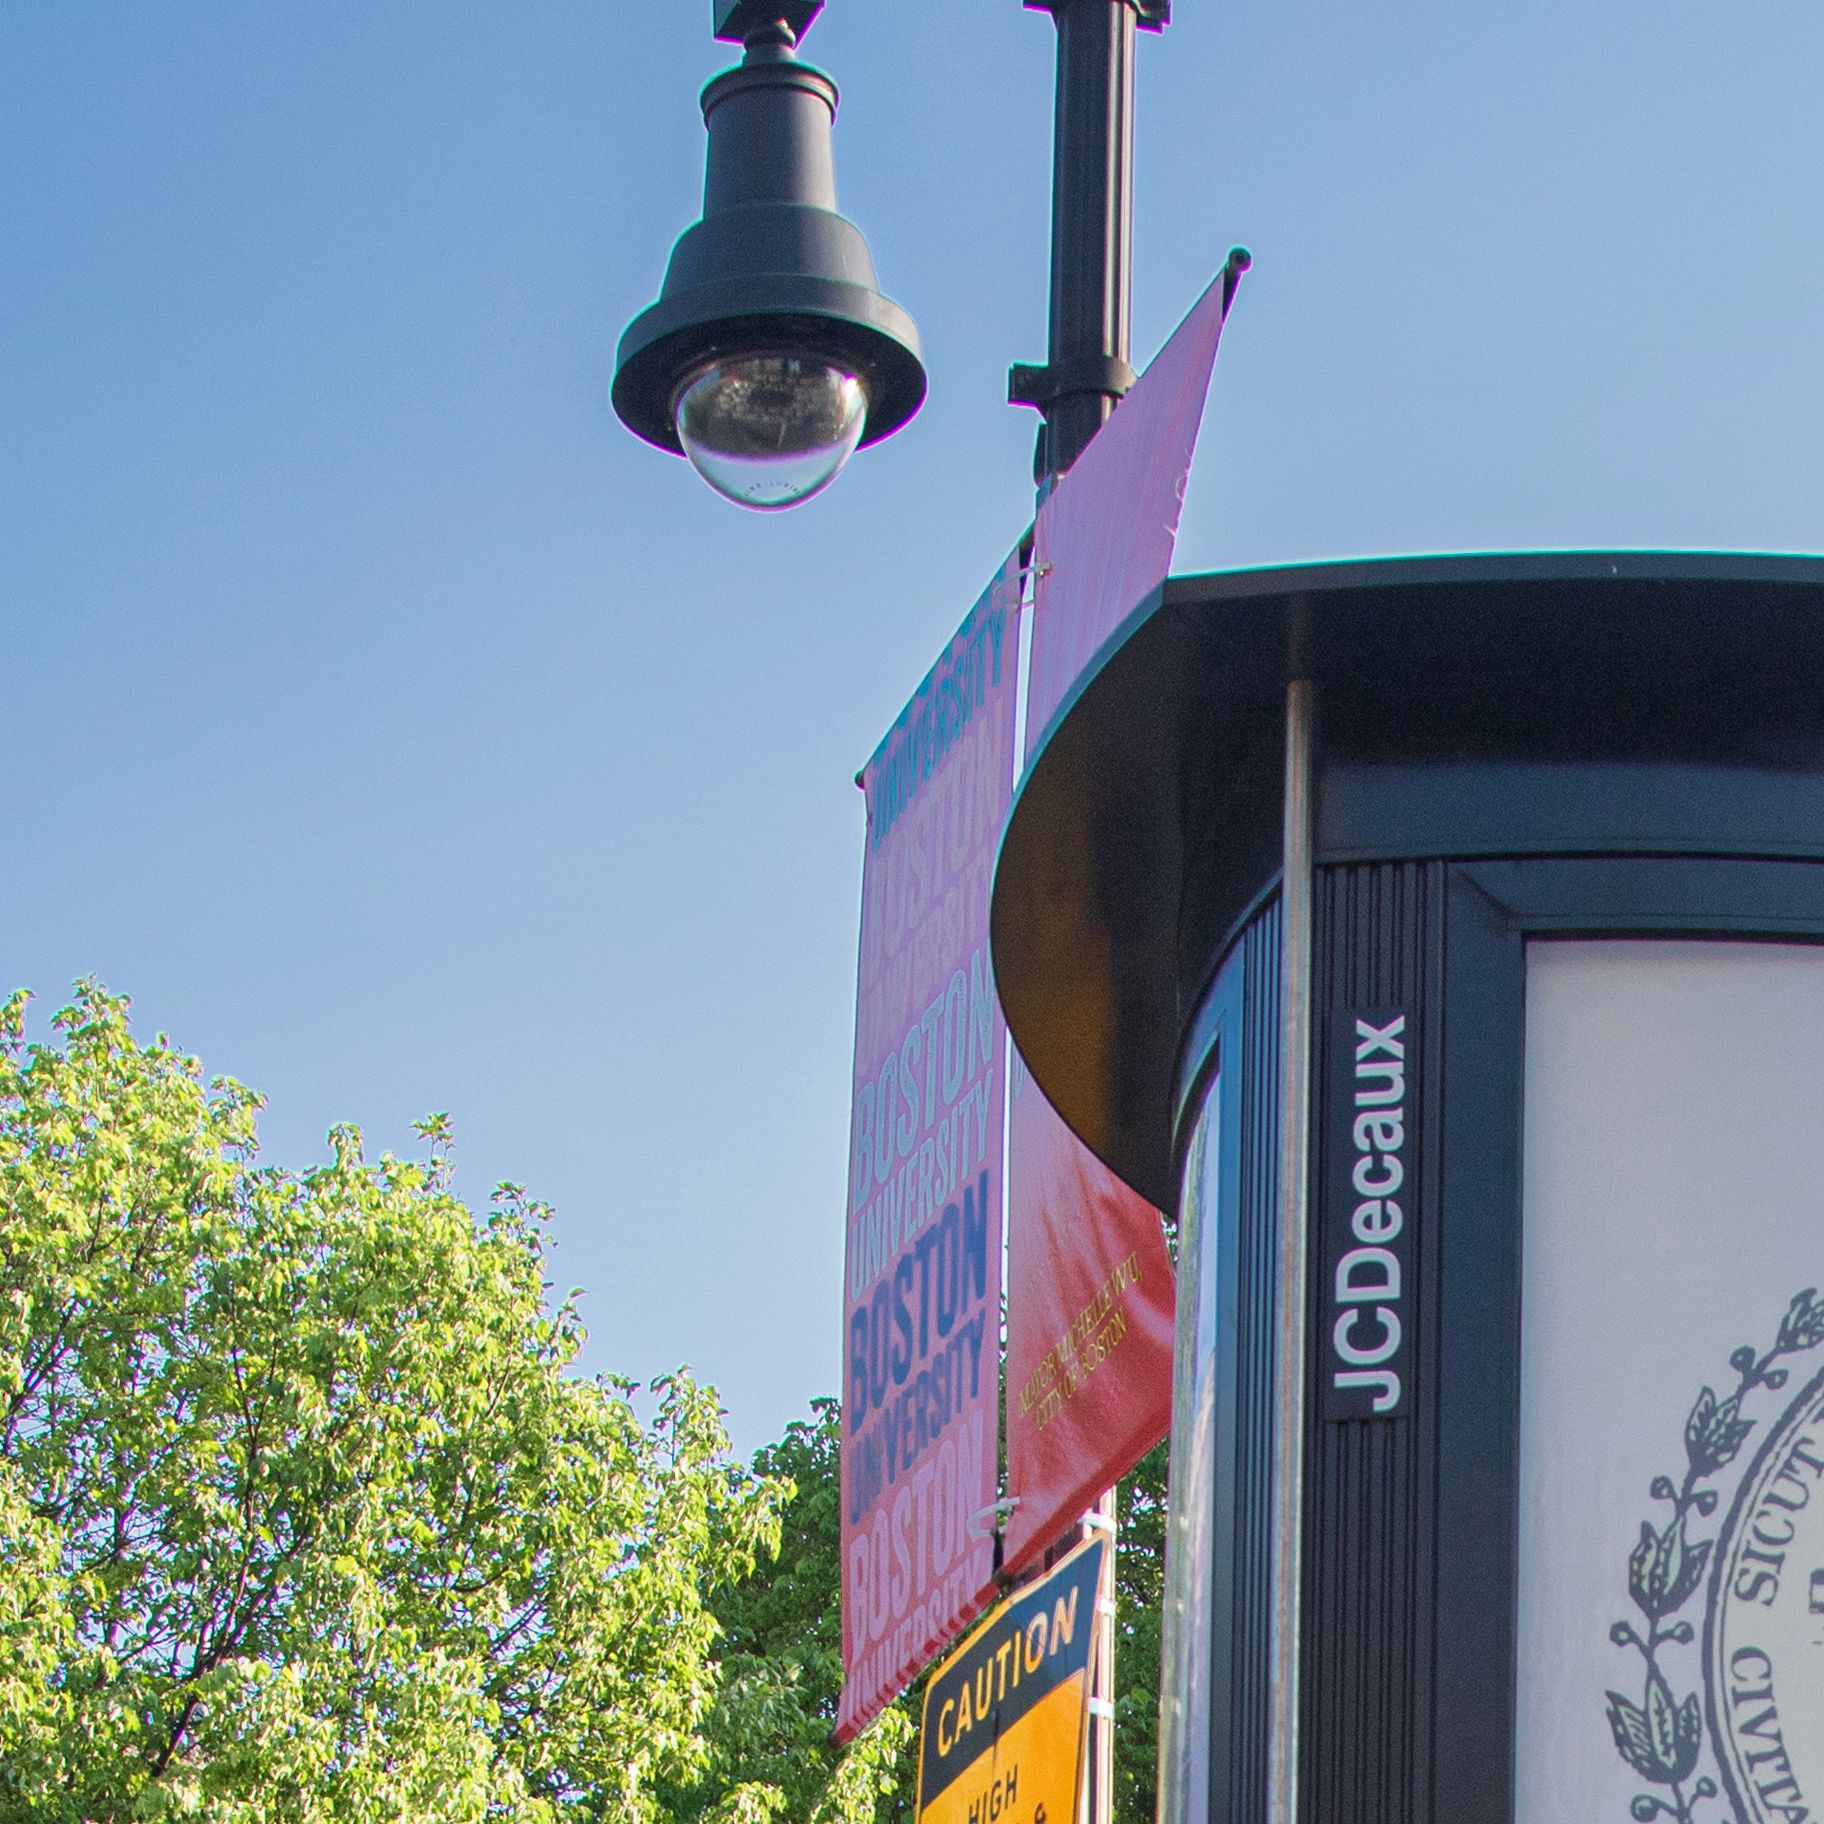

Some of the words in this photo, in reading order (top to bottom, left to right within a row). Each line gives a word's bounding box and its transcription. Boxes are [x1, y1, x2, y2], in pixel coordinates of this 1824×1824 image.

[872, 606, 1003, 853] UNIVERSITY
[850, 1068, 994, 1301] UNIVERSITY
[853, 937, 995, 1215] BOSTON
[849, 1169, 988, 1436] BOSTON
[1333, 1015, 1406, 1411] JCDecaux
[849, 1307, 985, 1525] UNIVERSITY
[1018, 1352, 1058, 1418] MAYOR
[1055, 1280, 1113, 1363] MICHELLE
[1079, 1305, 1128, 1380] BOSTON
[849, 1408, 985, 1664] BOSTON
[938, 1586, 1079, 1757] CAUTION
